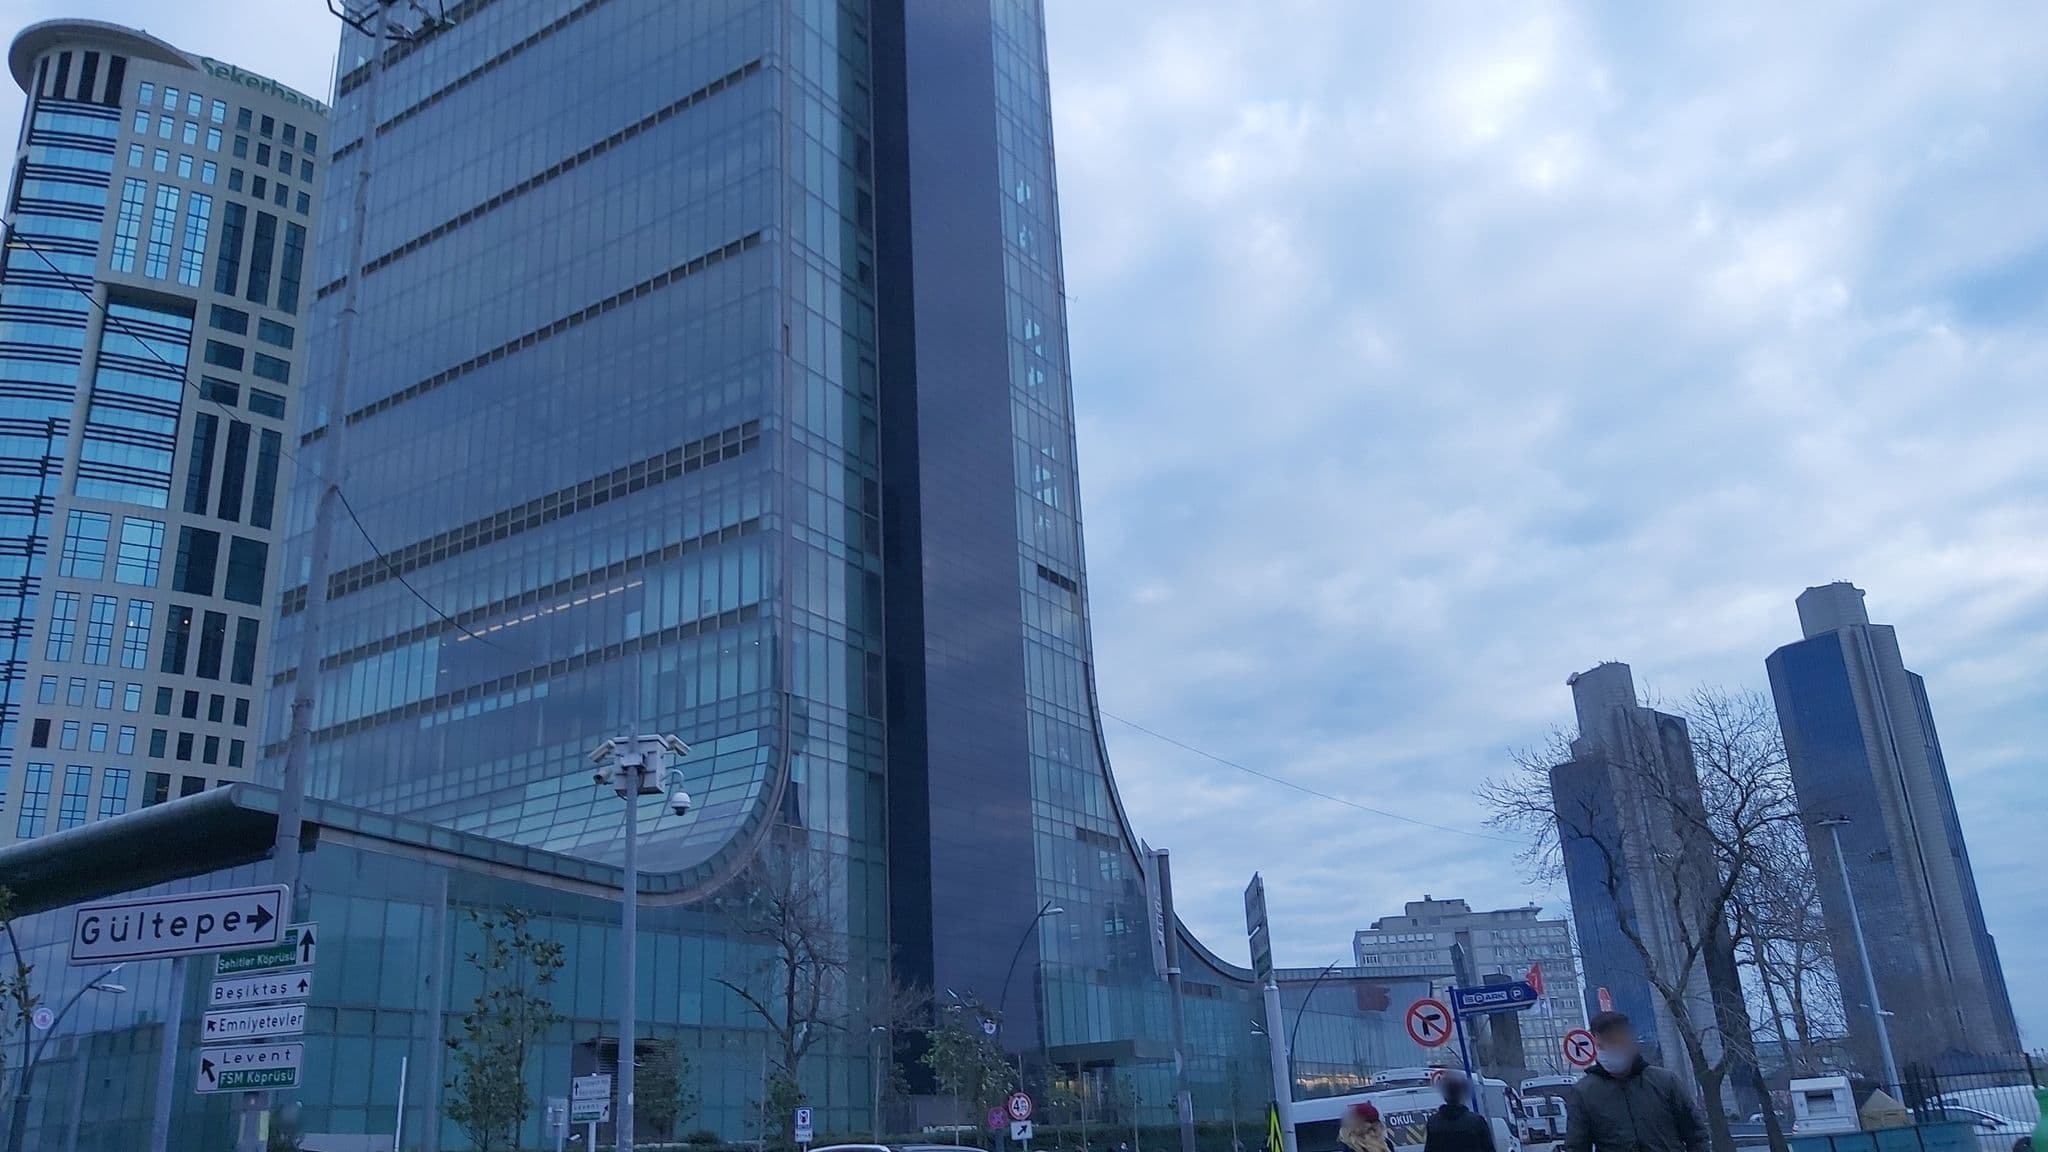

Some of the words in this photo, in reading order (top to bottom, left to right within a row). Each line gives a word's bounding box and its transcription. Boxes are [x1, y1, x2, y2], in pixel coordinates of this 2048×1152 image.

[81, 911, 241, 945] Gültepe
[215, 983, 287, 1000] Beşiktaş
[219, 1013, 303, 1033] Emniyetevler
[223, 1049, 291, 1064] Levent
[220, 1071, 244, 1085] FSM
[247, 1069, 294, 1085] Köprüsü
[1389, 1114, 1415, 1126] OKUL
